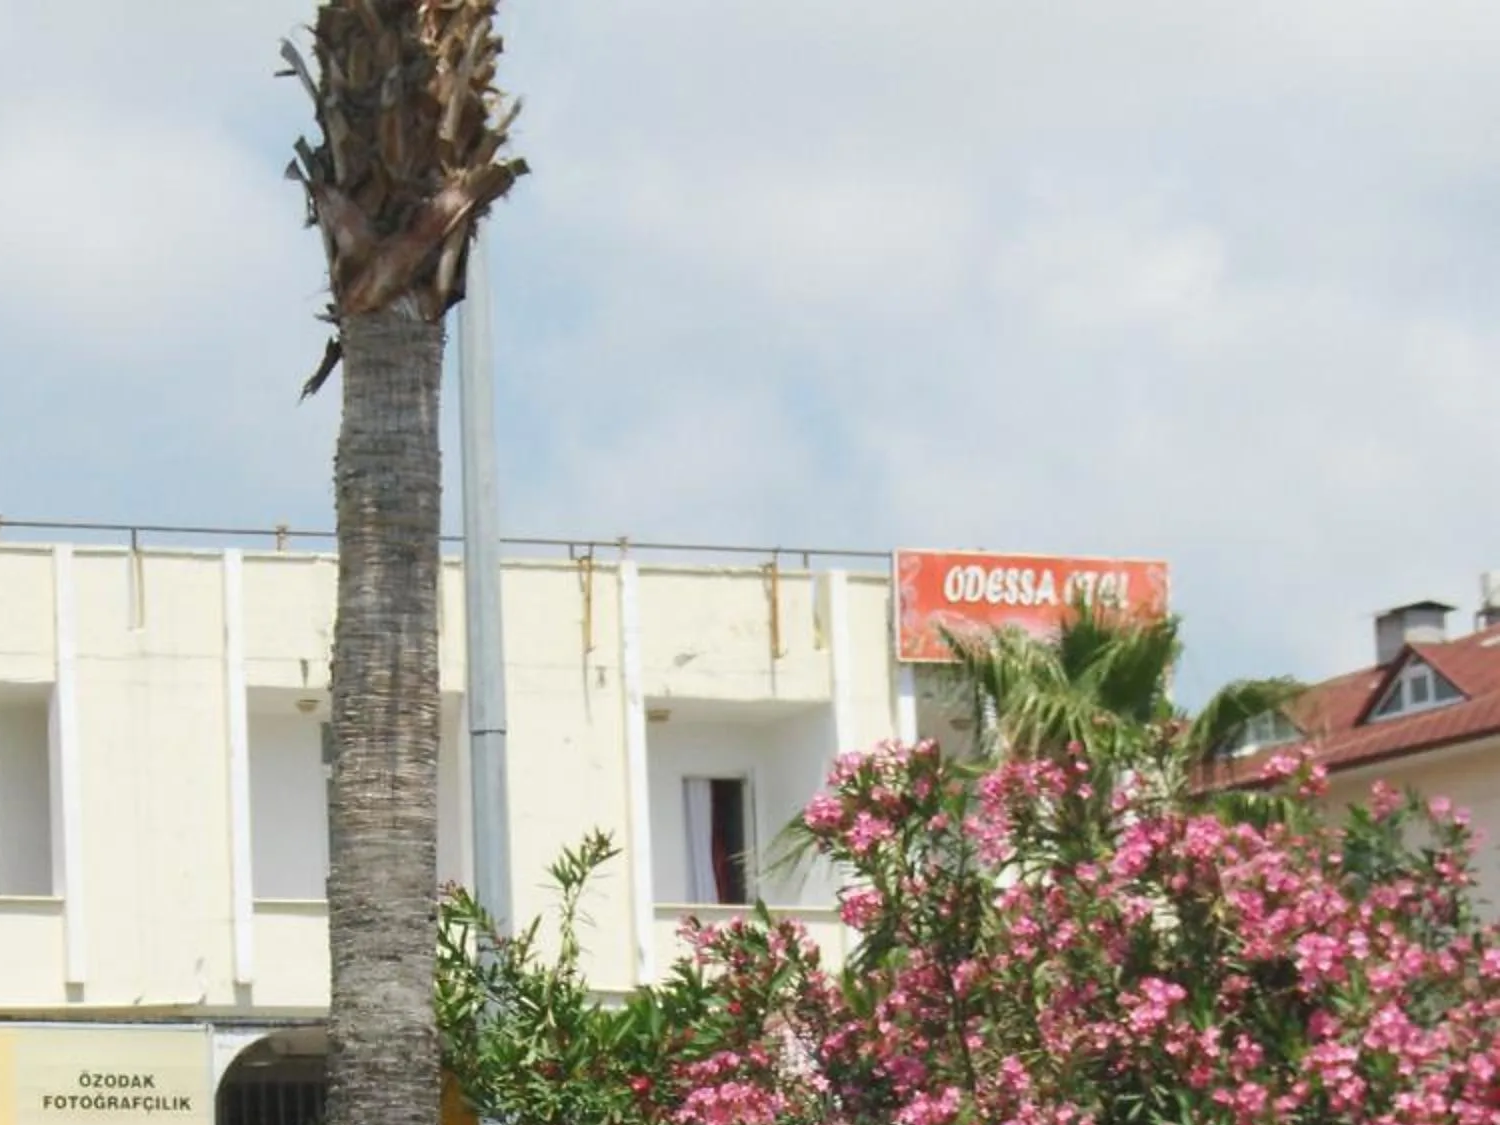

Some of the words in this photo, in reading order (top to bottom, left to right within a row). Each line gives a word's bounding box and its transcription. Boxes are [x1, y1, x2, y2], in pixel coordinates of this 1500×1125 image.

[944, 565, 1059, 606] ODESSA
[78, 1070, 156, 1089] ÖZODAK
[42, 1092, 192, 1114] FOTOĞRAFÇILIK
